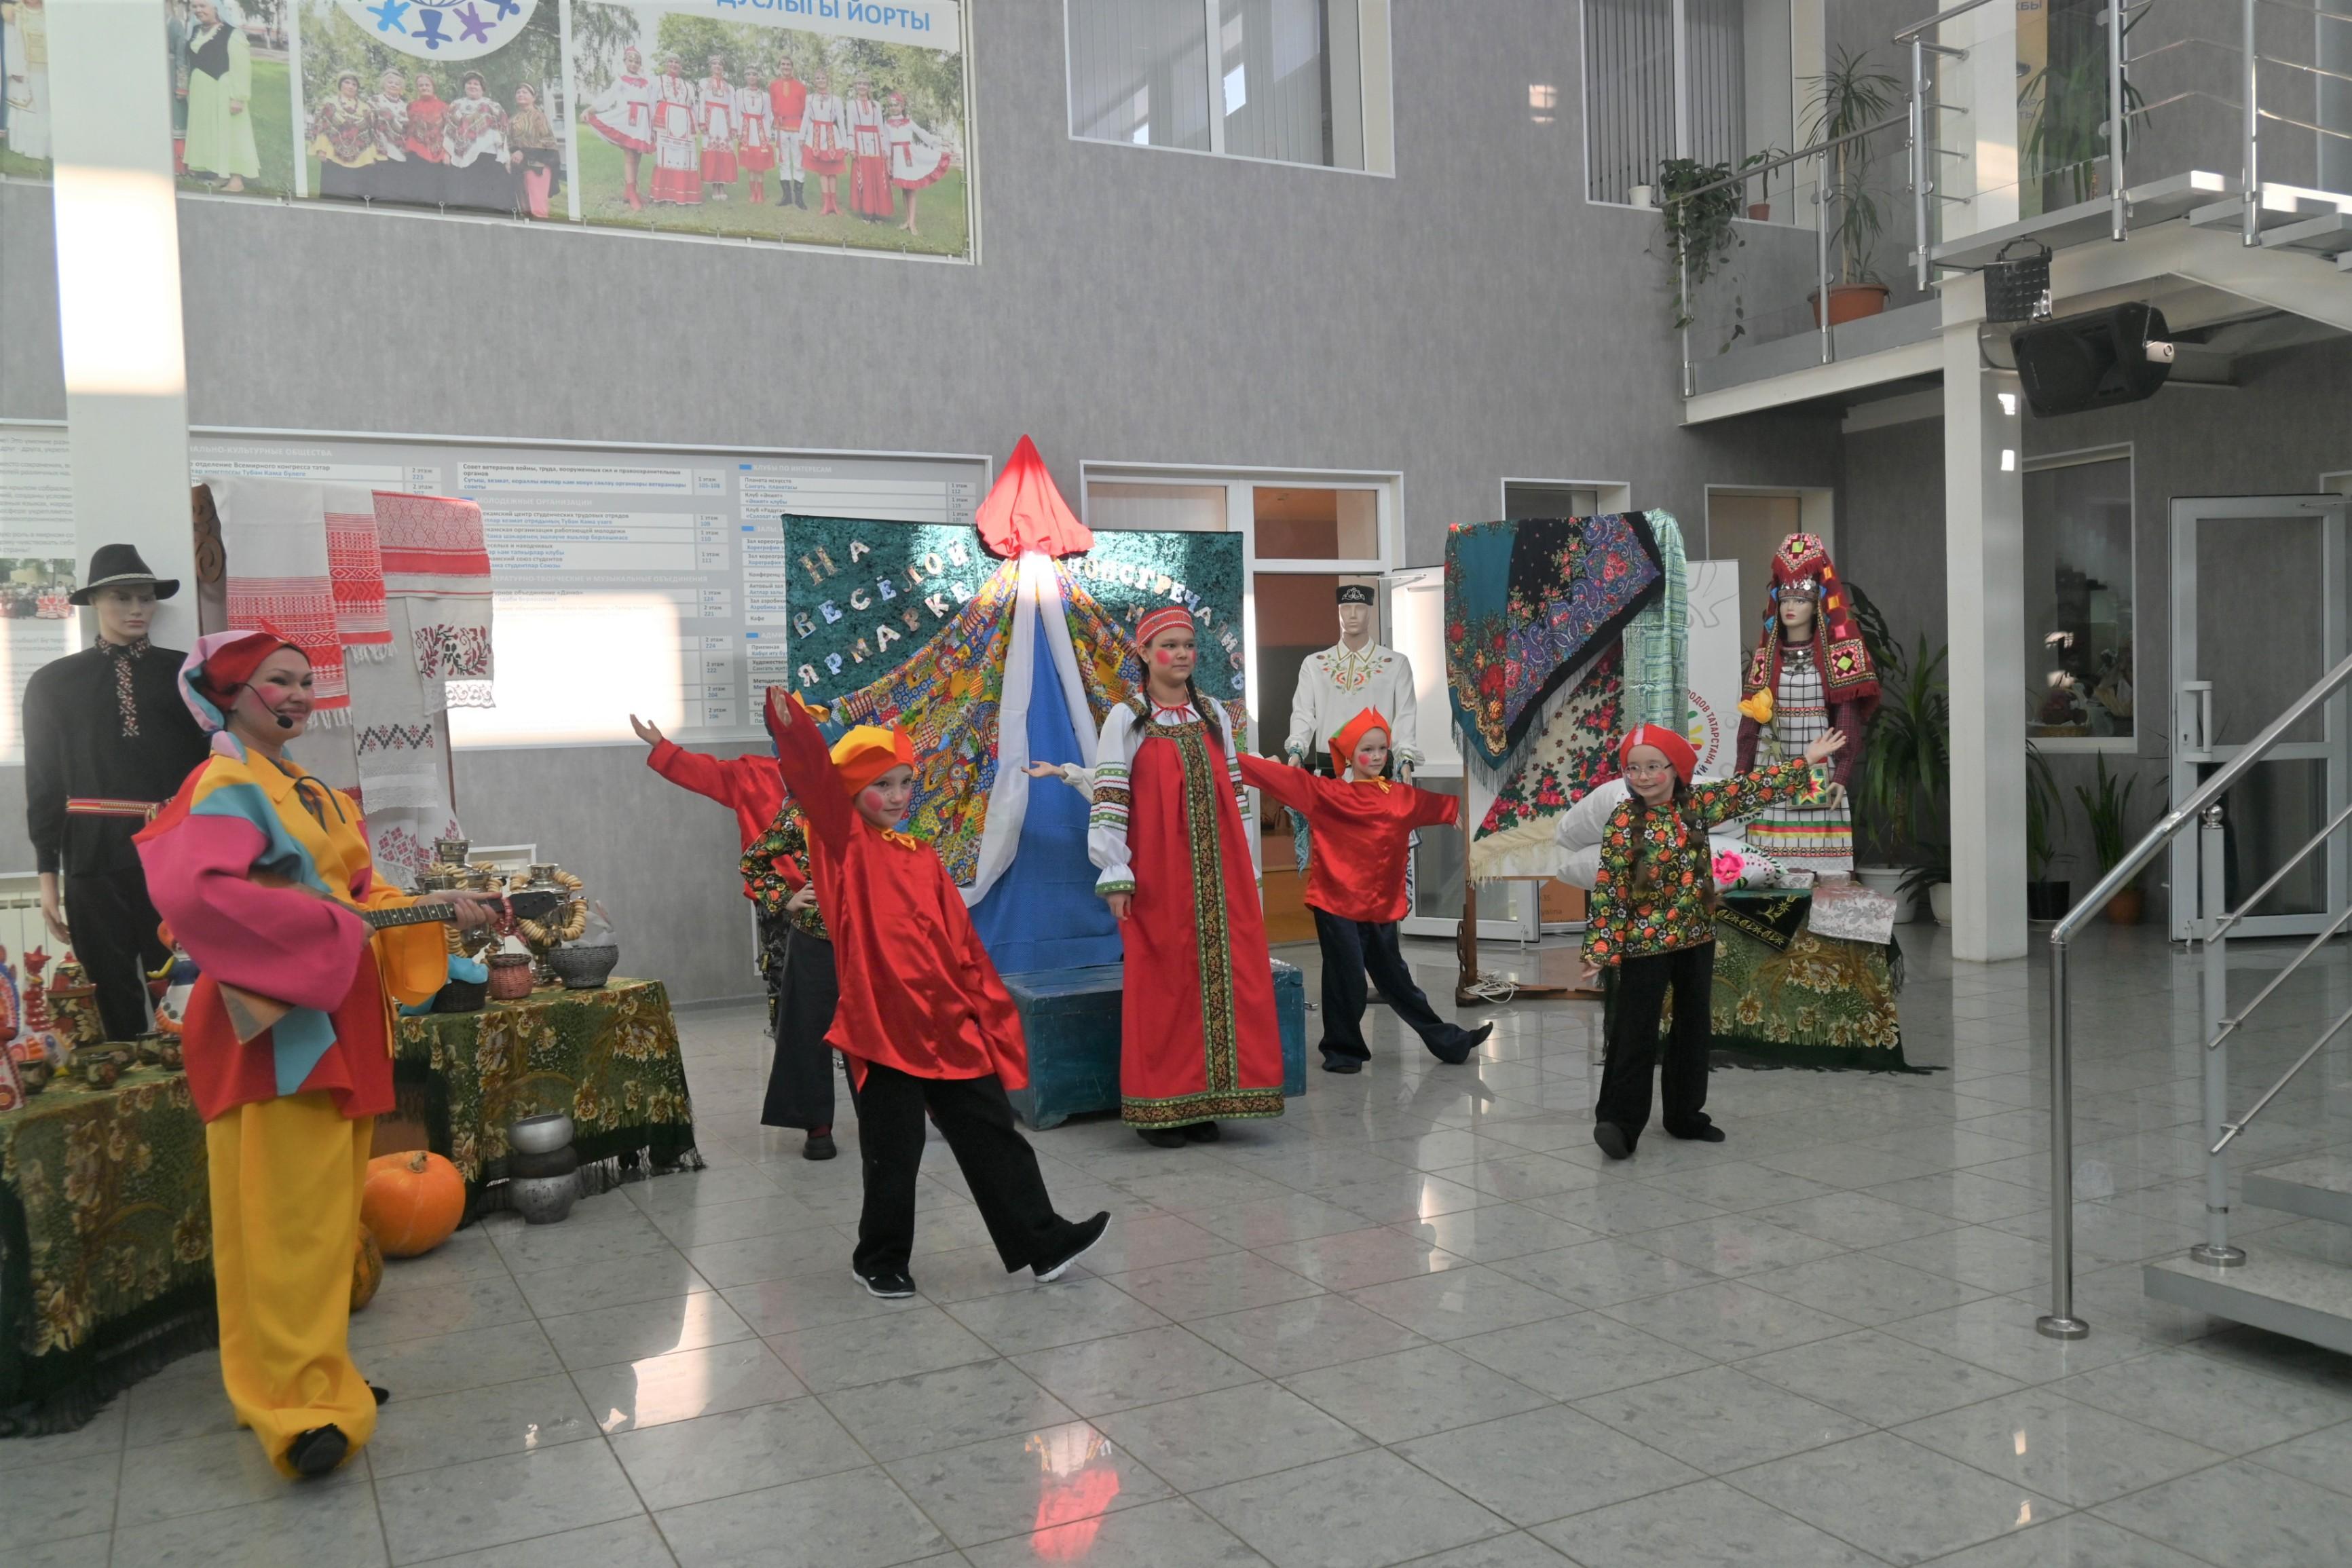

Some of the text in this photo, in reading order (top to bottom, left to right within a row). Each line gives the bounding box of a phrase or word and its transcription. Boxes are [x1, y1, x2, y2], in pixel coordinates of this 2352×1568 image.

[848, 0, 930, 31] ЙОРТЫ
[798, 540, 870, 586] НА
[797, 581, 972, 688] ЯРМАРКЕ
[1704, 711, 1720, 766] ТАТАРСТАНА
